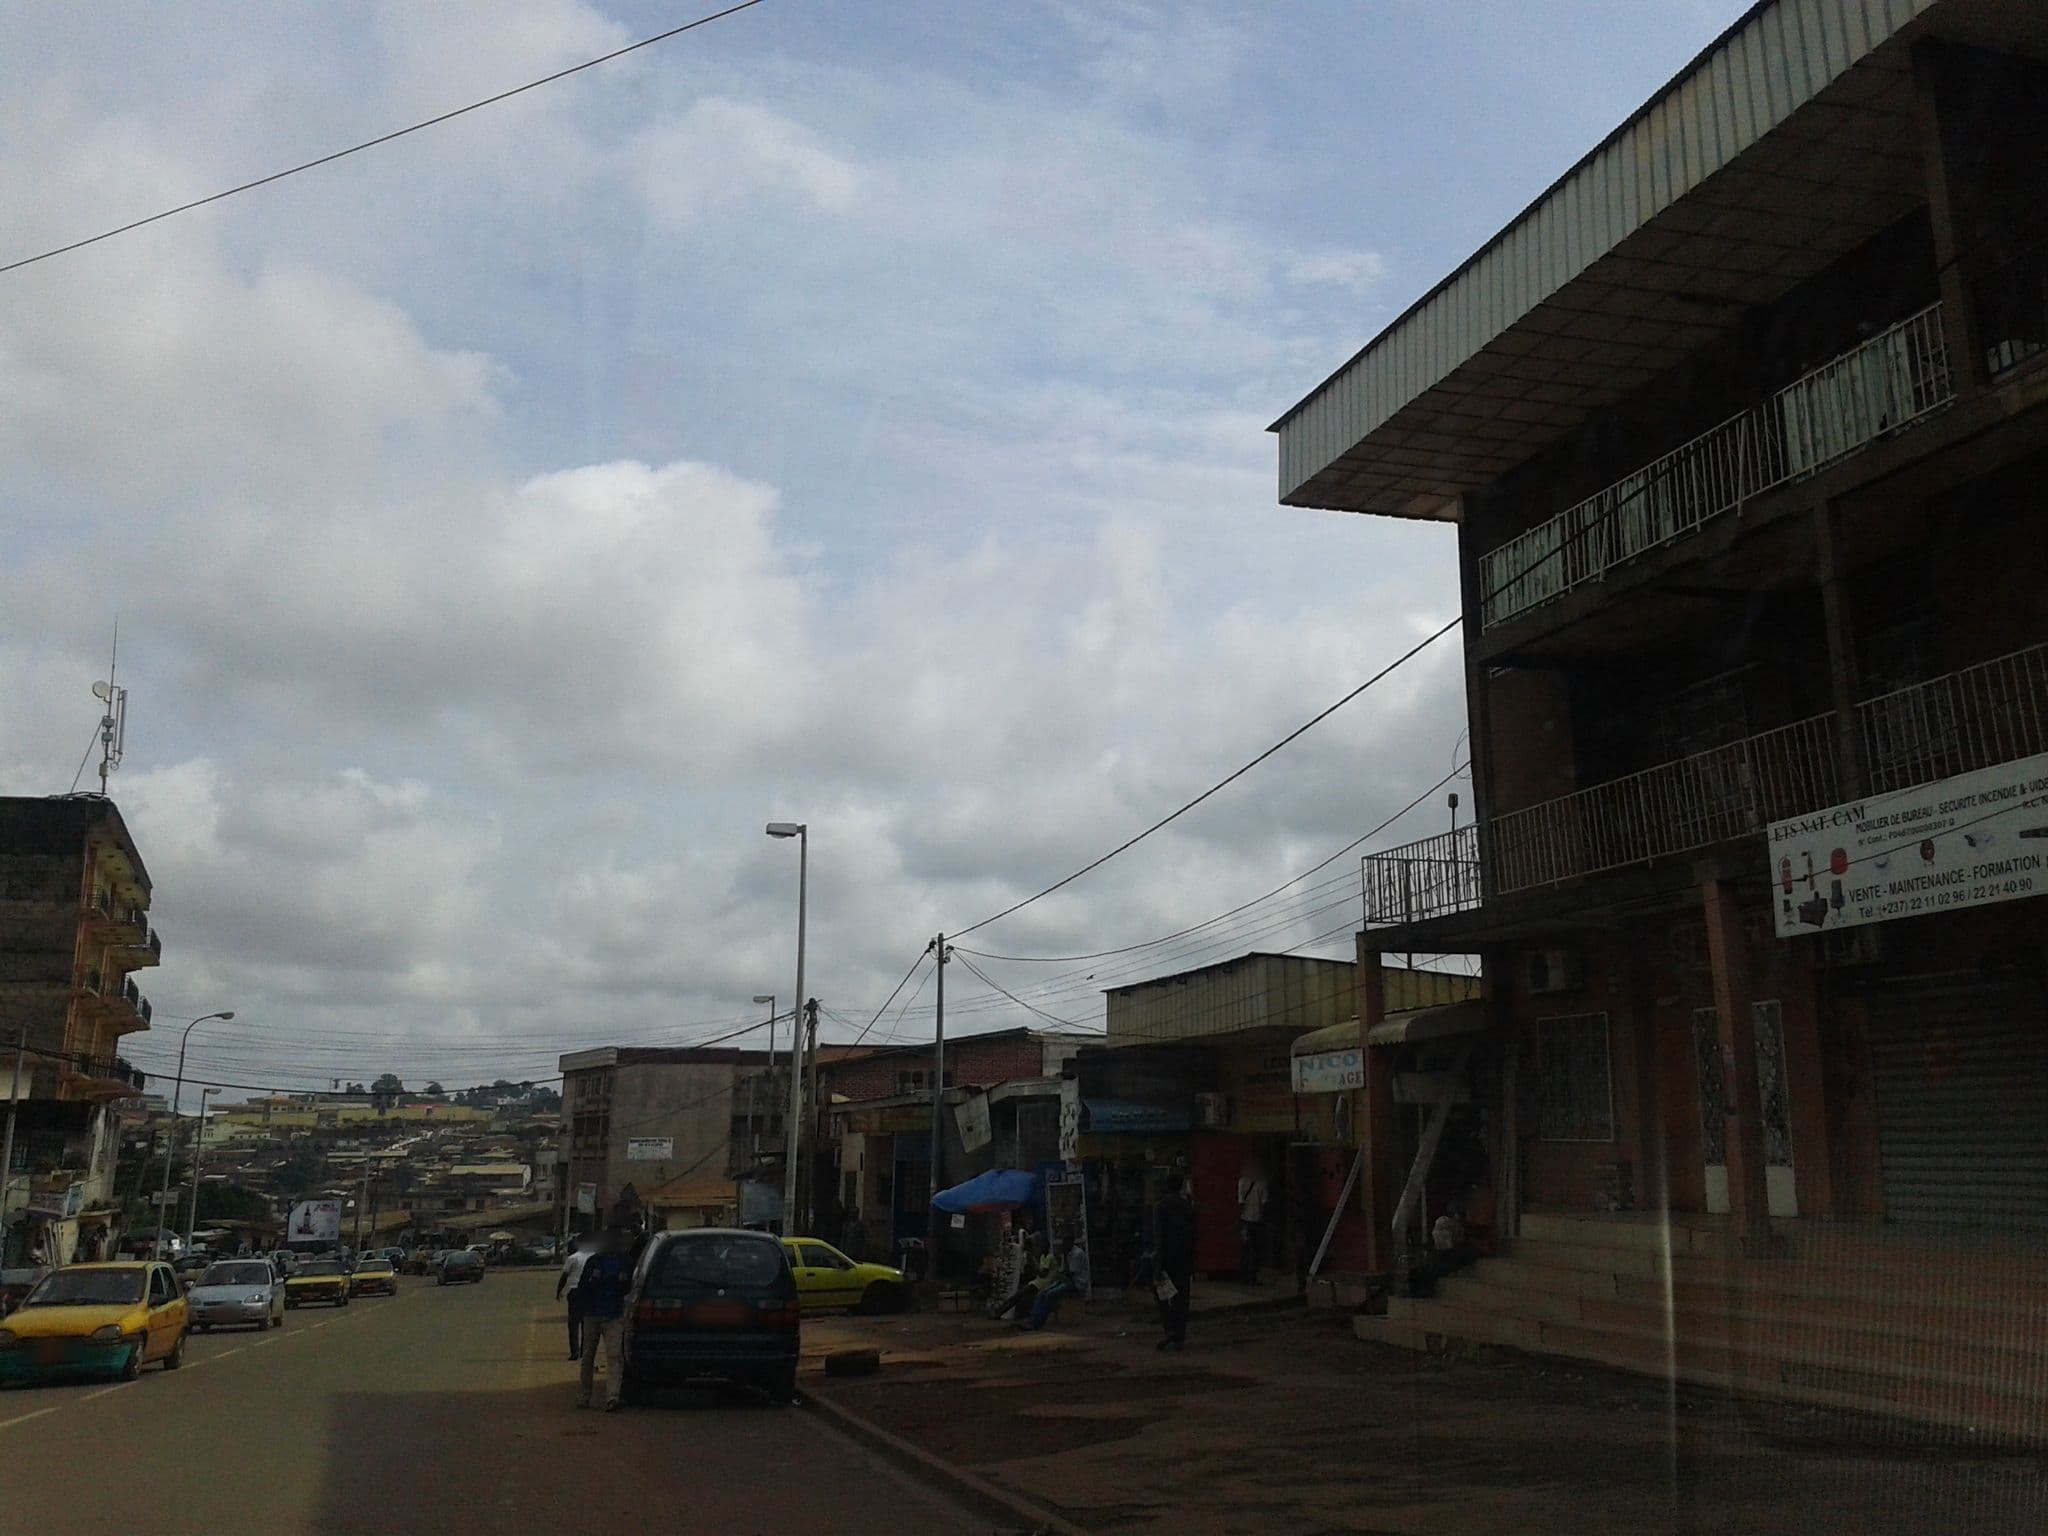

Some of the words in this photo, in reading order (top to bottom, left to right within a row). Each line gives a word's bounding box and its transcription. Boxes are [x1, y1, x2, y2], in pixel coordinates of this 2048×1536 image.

[1832, 806, 1865, 827] CAM
[1856, 816, 1889, 833] MOBILIER
[1890, 813, 1901, 826] DE
[1902, 806, 1933, 823] BUREAU
[1978, 785, 2017, 804] INCENDIE
[1849, 884, 1880, 902] VENTE
[1889, 868, 1965, 896] MAINTENANCE
[1973, 855, 2040, 880] FORMATION
[1910, 897, 1921, 909] 22
[1925, 895, 1935, 907] 11
[1938, 892, 1950, 905] 02
[1952, 890, 1964, 903] 96
[1974, 885, 1986, 899] 22
[1989, 883, 2000, 897] 21
[2003, 880, 2017, 893] 40
[2019, 877, 2032, 891] 90
